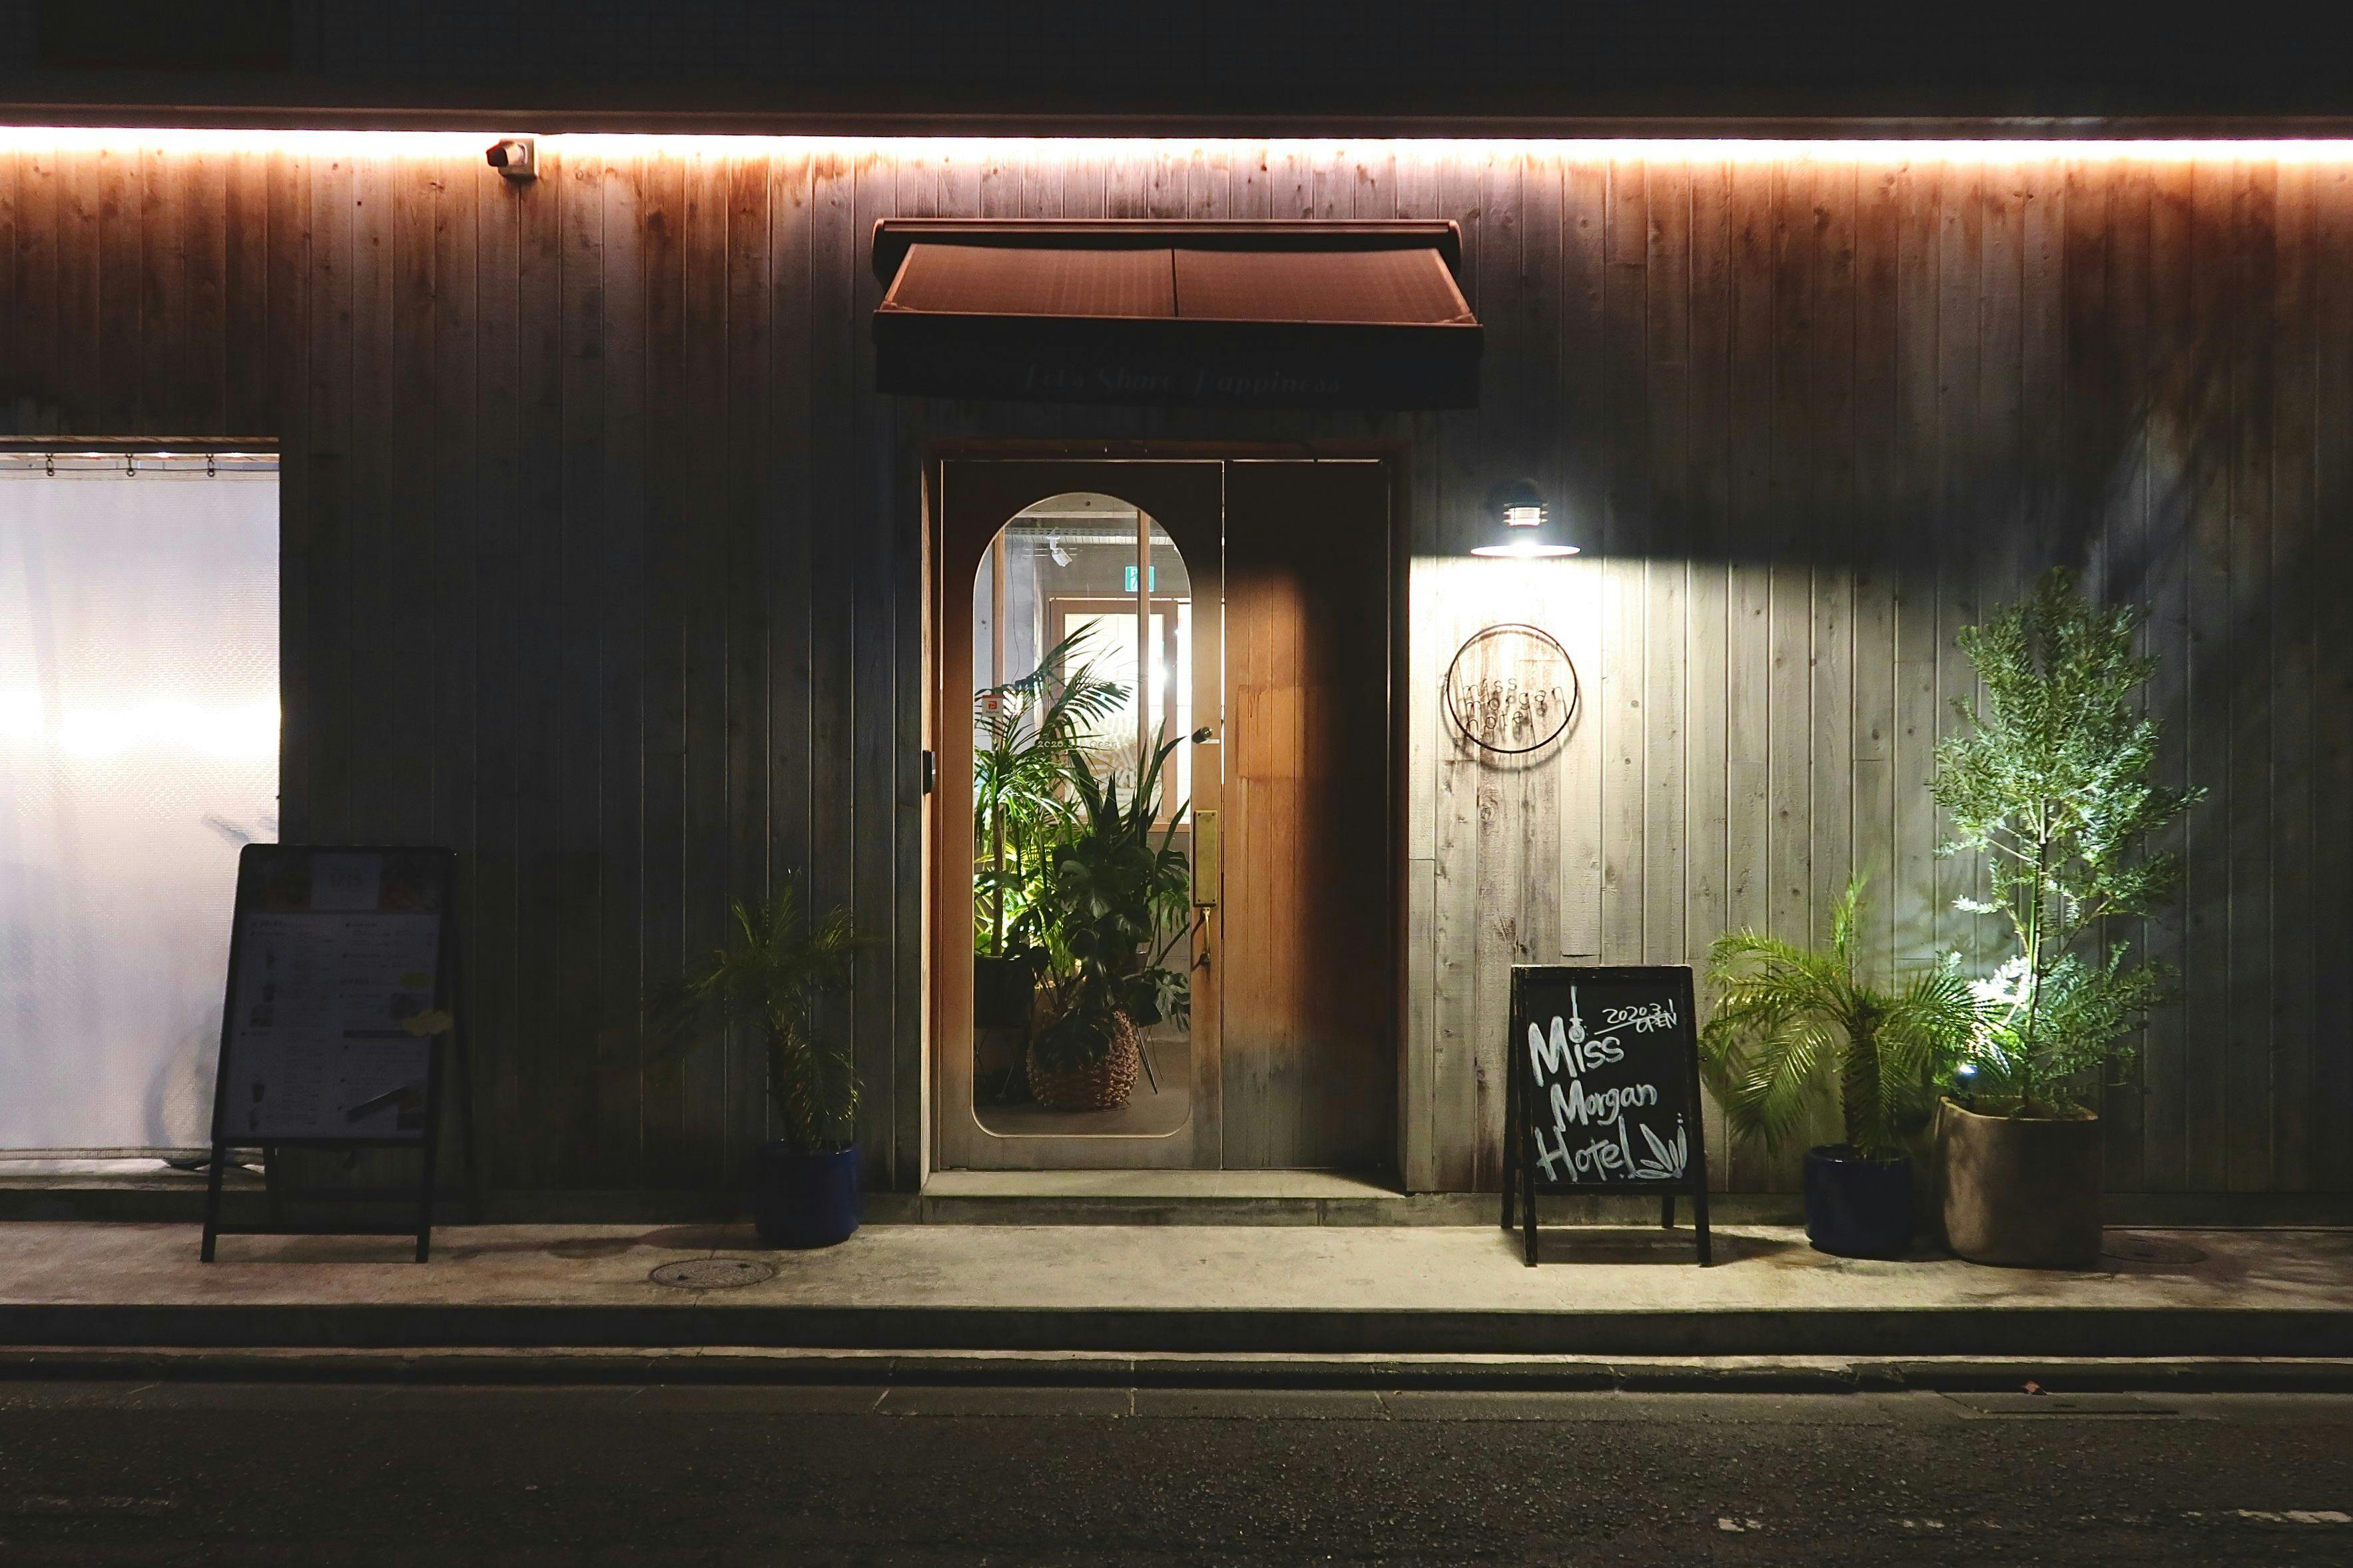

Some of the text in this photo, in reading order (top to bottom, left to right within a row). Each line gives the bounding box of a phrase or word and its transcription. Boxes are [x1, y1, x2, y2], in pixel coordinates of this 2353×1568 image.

[1528, 1015, 1625, 1087] Miss
[1634, 1011, 1678, 1033] OPEN
[1550, 1079, 1658, 1132] Morgan
[1534, 1115, 1637, 1182] Hotel
